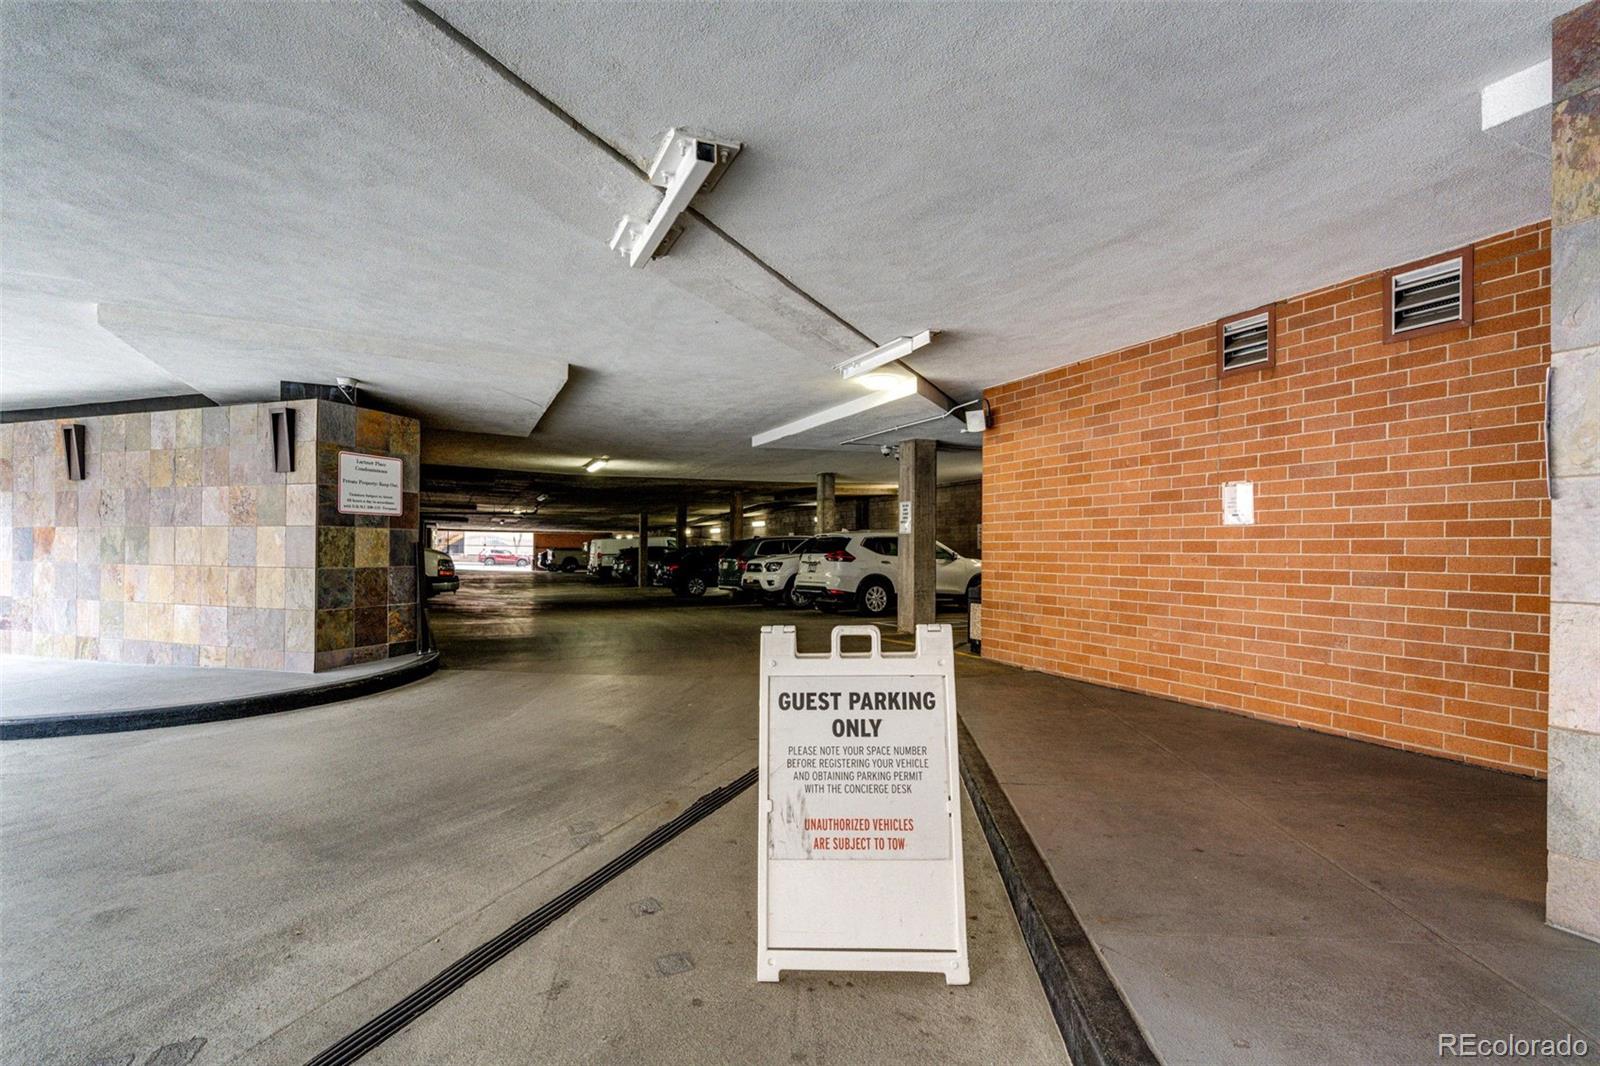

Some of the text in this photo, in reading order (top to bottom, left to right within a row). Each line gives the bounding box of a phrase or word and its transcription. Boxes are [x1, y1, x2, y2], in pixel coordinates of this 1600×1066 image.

[778, 692, 936, 711] GUEST PARKING
[832, 719, 882, 737] ONLY
[788, 746, 928, 756] PLEASE NOTE YOUR SPACE NUMBER
[786, 758, 929, 769] BEFORE REGISTERING YOUR VEHICLE
[793, 771, 923, 781] AND OBTAINING PARKING PERMIT
[804, 784, 912, 794] WITH THE CONCIERGE DESK
[804, 818, 914, 832] UNAUTHORIZED VEHICLES
[813, 837, 906, 851] ARE SUBJECT TO TOW
